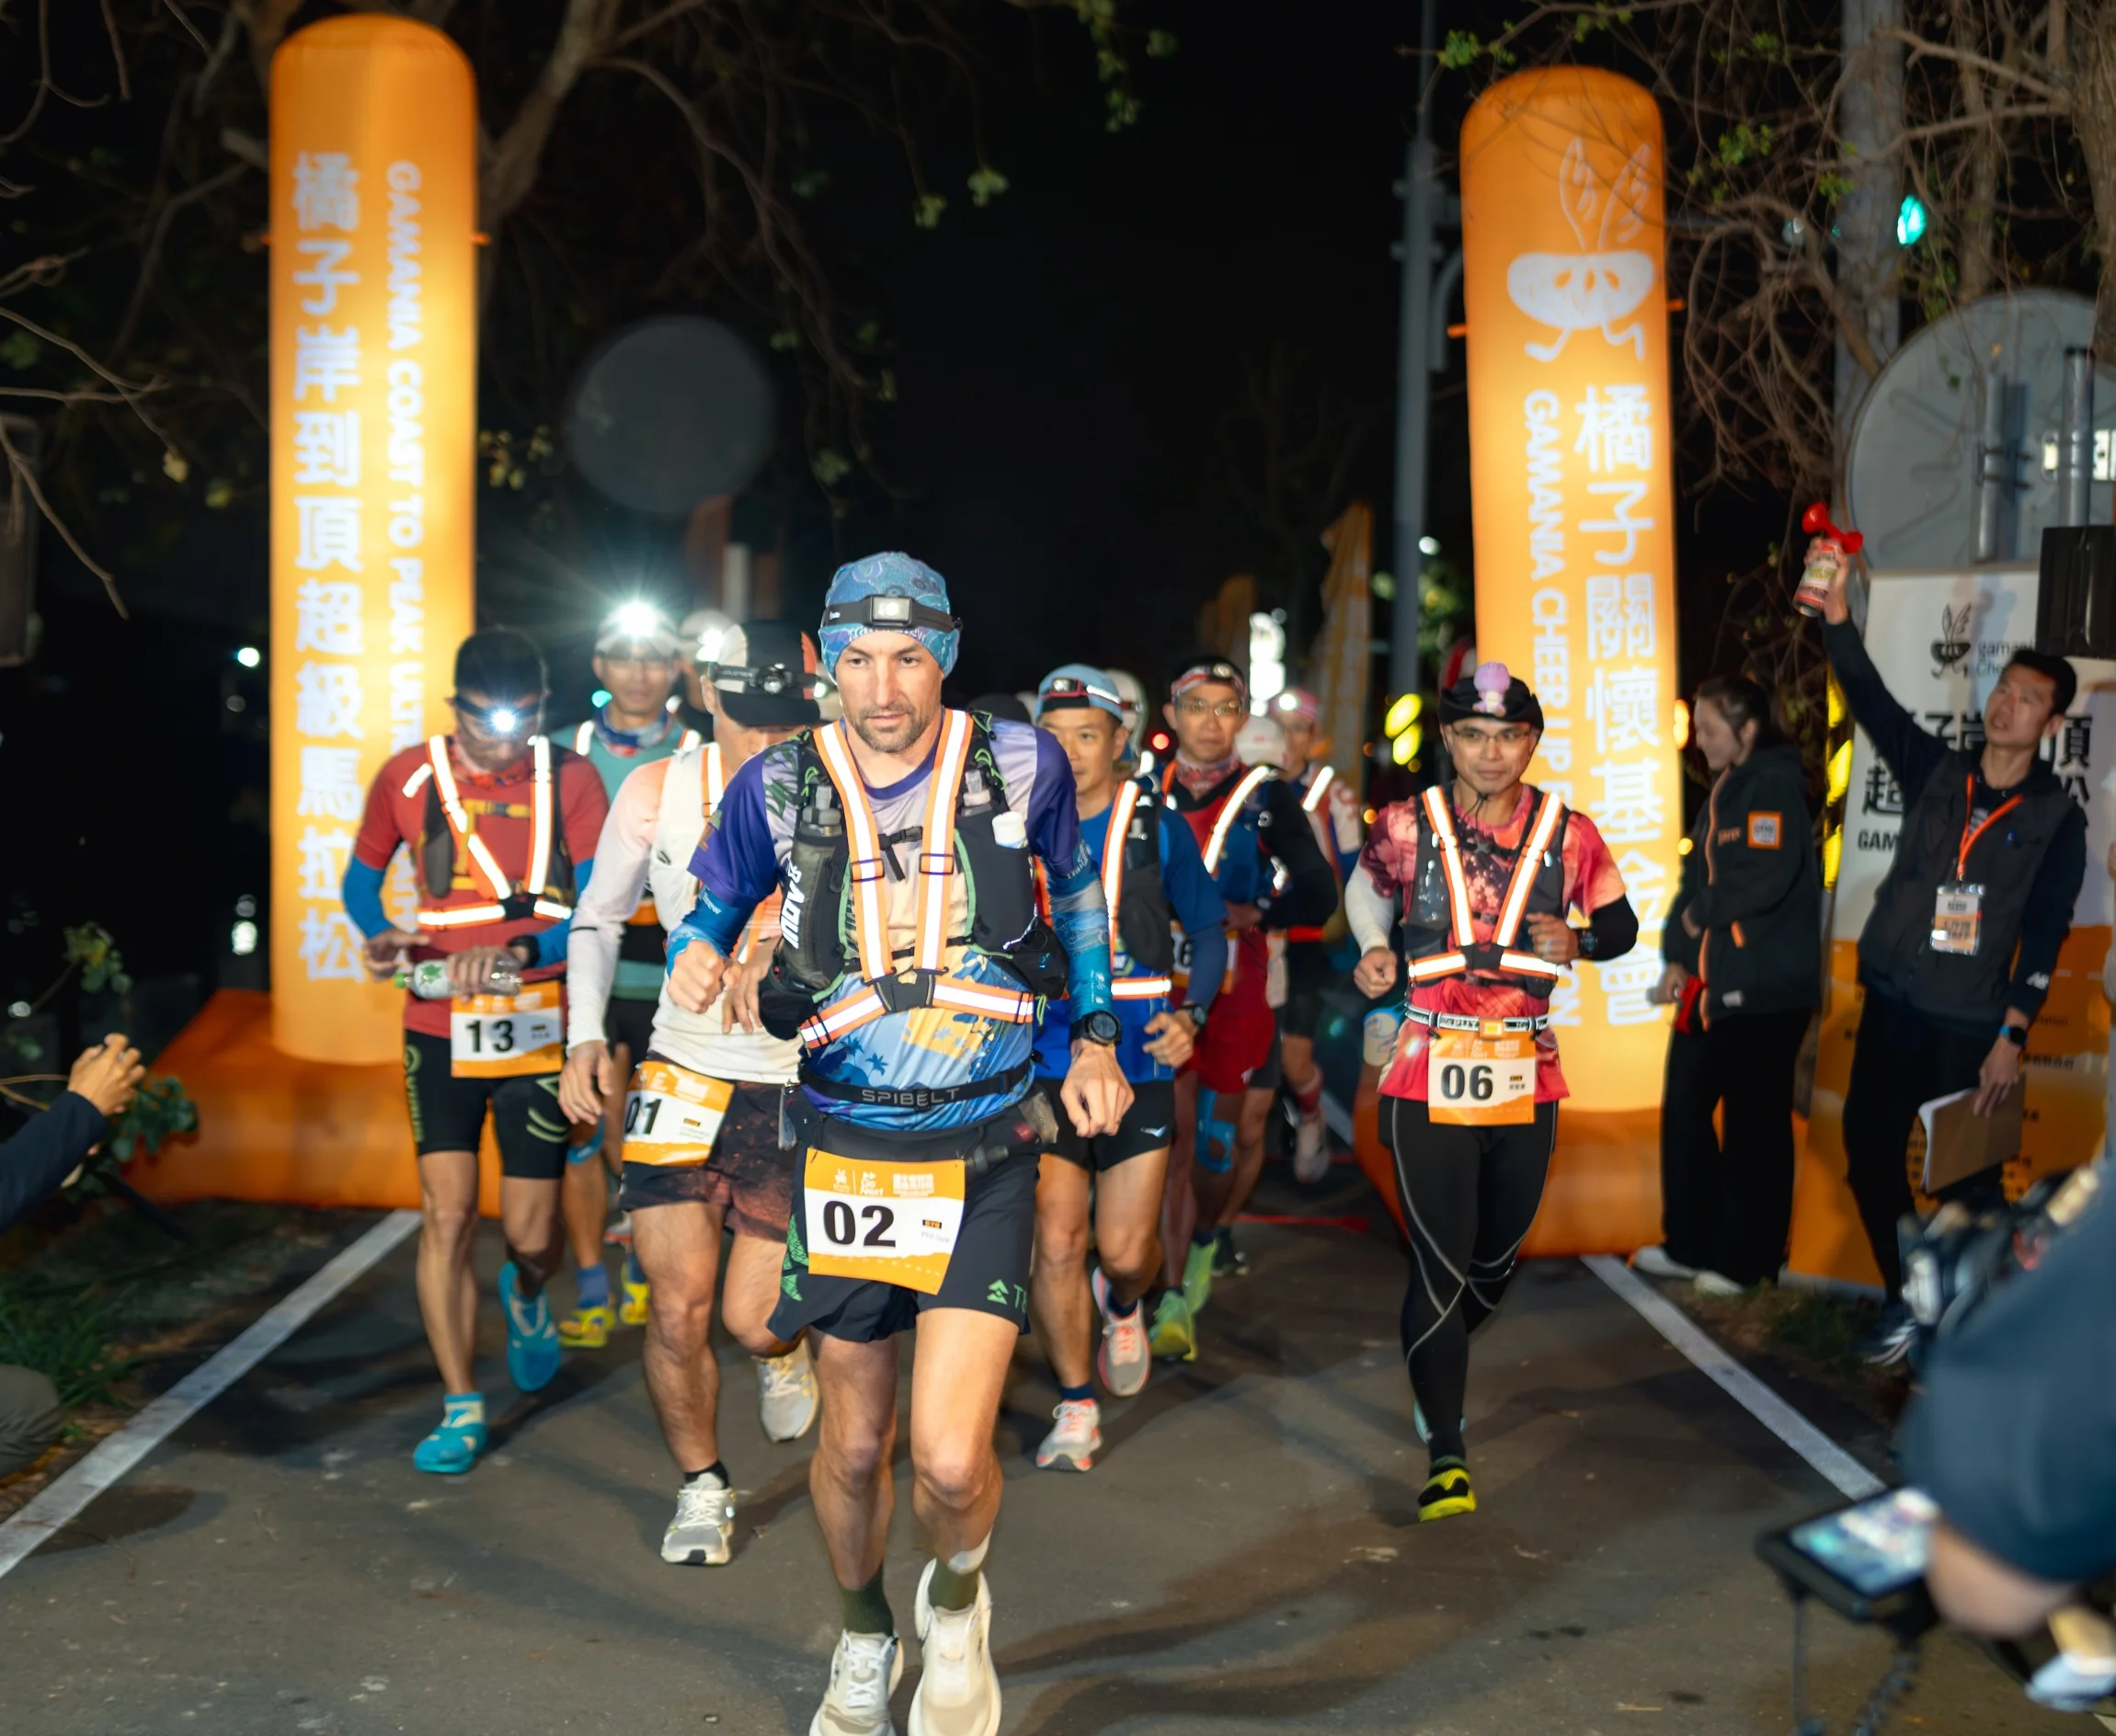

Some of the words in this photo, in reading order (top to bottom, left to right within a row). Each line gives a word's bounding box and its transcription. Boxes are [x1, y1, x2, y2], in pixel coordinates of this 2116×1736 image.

[386, 161, 422, 349] GAMANIA
[387, 359, 424, 485] COAST
[388, 494, 424, 548] TO
[1523, 389, 1567, 581] GAMANIA
[389, 556, 425, 654] PEAK
[1531, 587, 1573, 710] CHEER
[390, 662, 425, 755] ULTR
[1574, 383, 1666, 1027] 橘子關懷基金會
[1538, 717, 1573, 773] UP
[465, 1019, 514, 1054] 13
[624, 1096, 662, 1135] 01
[862, 1087, 960, 1107] SPIBELT
[1440, 1064, 1493, 1101] 06
[823, 1200, 896, 1248] 02
